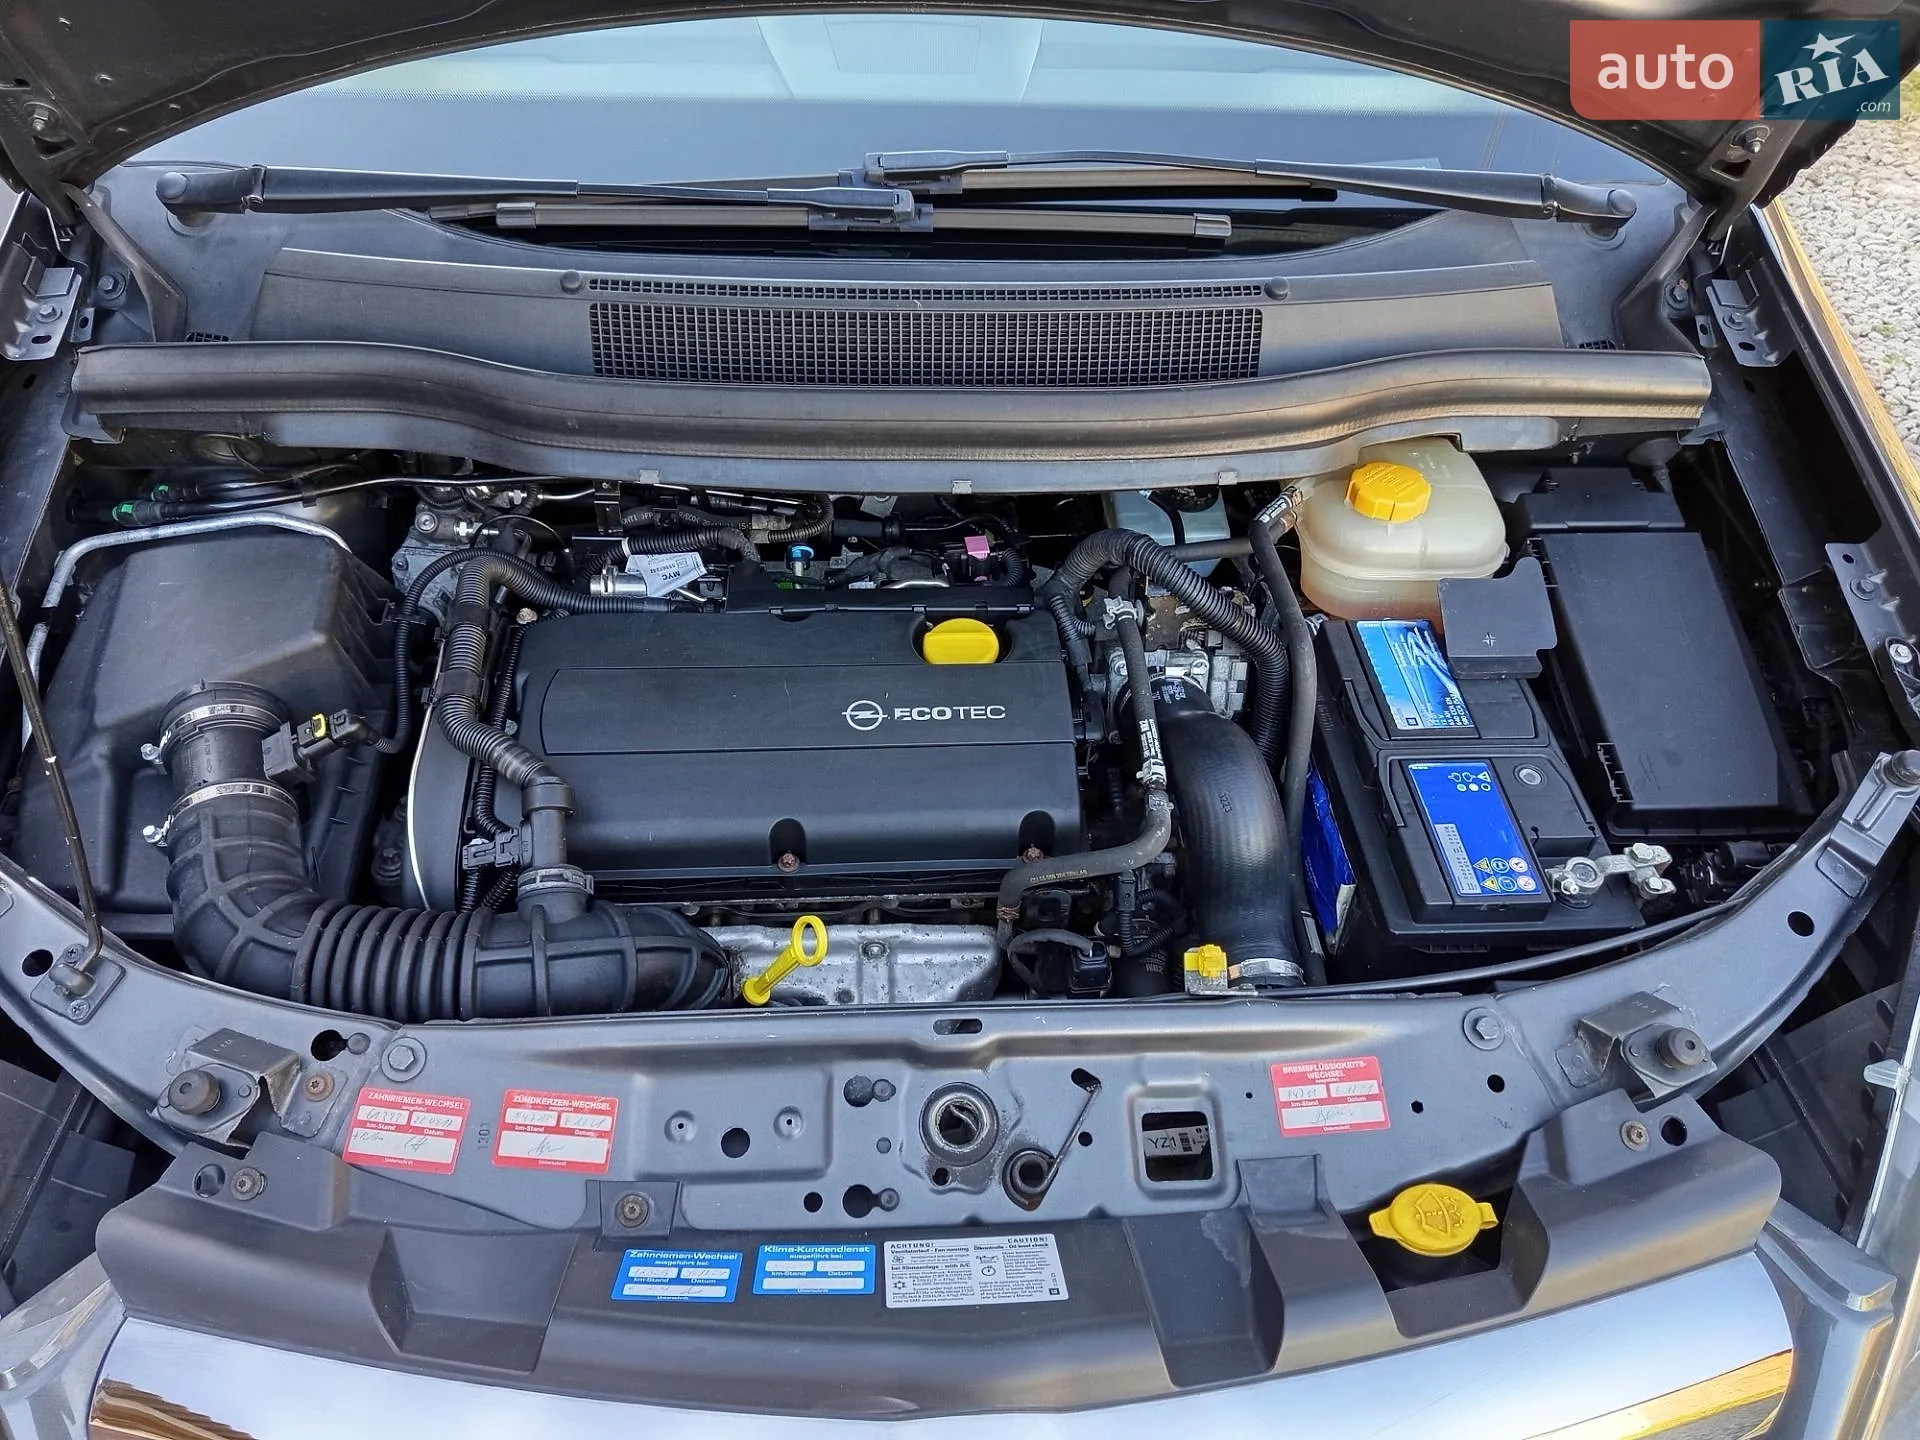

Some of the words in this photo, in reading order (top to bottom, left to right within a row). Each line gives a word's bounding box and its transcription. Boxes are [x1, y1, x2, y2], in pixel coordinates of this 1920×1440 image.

[662, 570, 681, 580] MYC
[894, 705, 1006, 721] ECOTEC
[1306, 1070, 1346, 1080] WECHSEL
[368, 1092, 465, 1110] ZAHNRIEMEN-WECHSEL
[512, 1095, 612, 1110] ZÜNDKERZEN-WECHSEL
[1148, 1136, 1177, 1149] YZ1
[1008, 1236, 1048, 1244] CAUTION!
[630, 1251, 738, 1260] Zahnriemen-Wechsel
